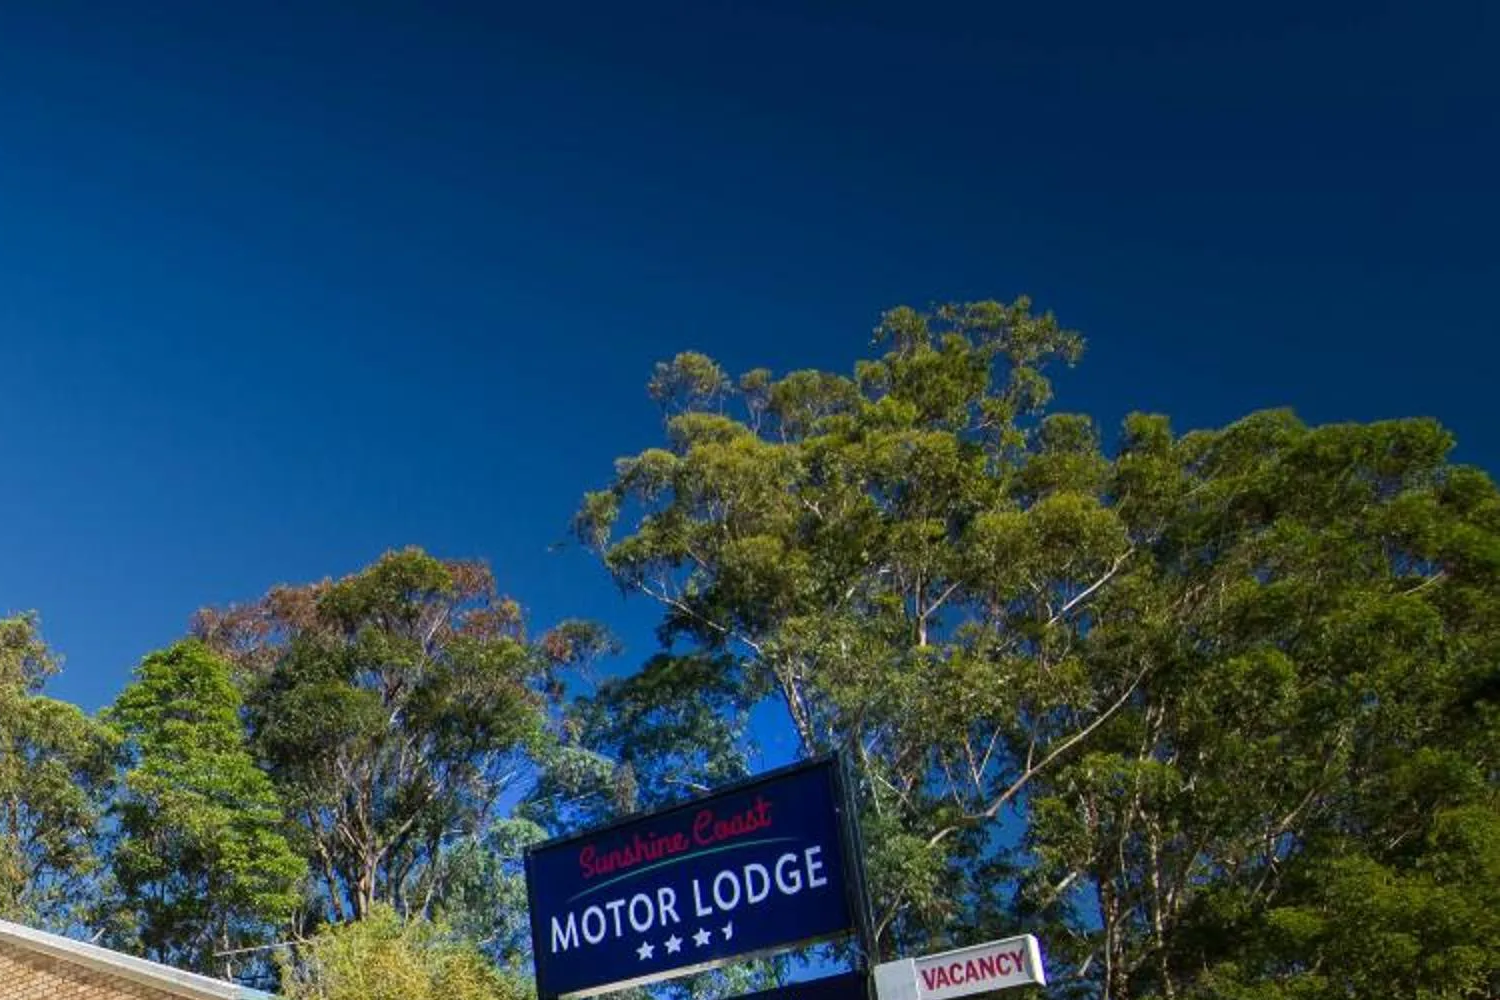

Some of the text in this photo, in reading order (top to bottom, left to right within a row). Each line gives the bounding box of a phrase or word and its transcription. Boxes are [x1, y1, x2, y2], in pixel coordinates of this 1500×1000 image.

[579, 800, 773, 879] Sunshine Coast
[550, 845, 828, 953] MOTOR LODGE
[920, 948, 1025, 991] VACANCY
